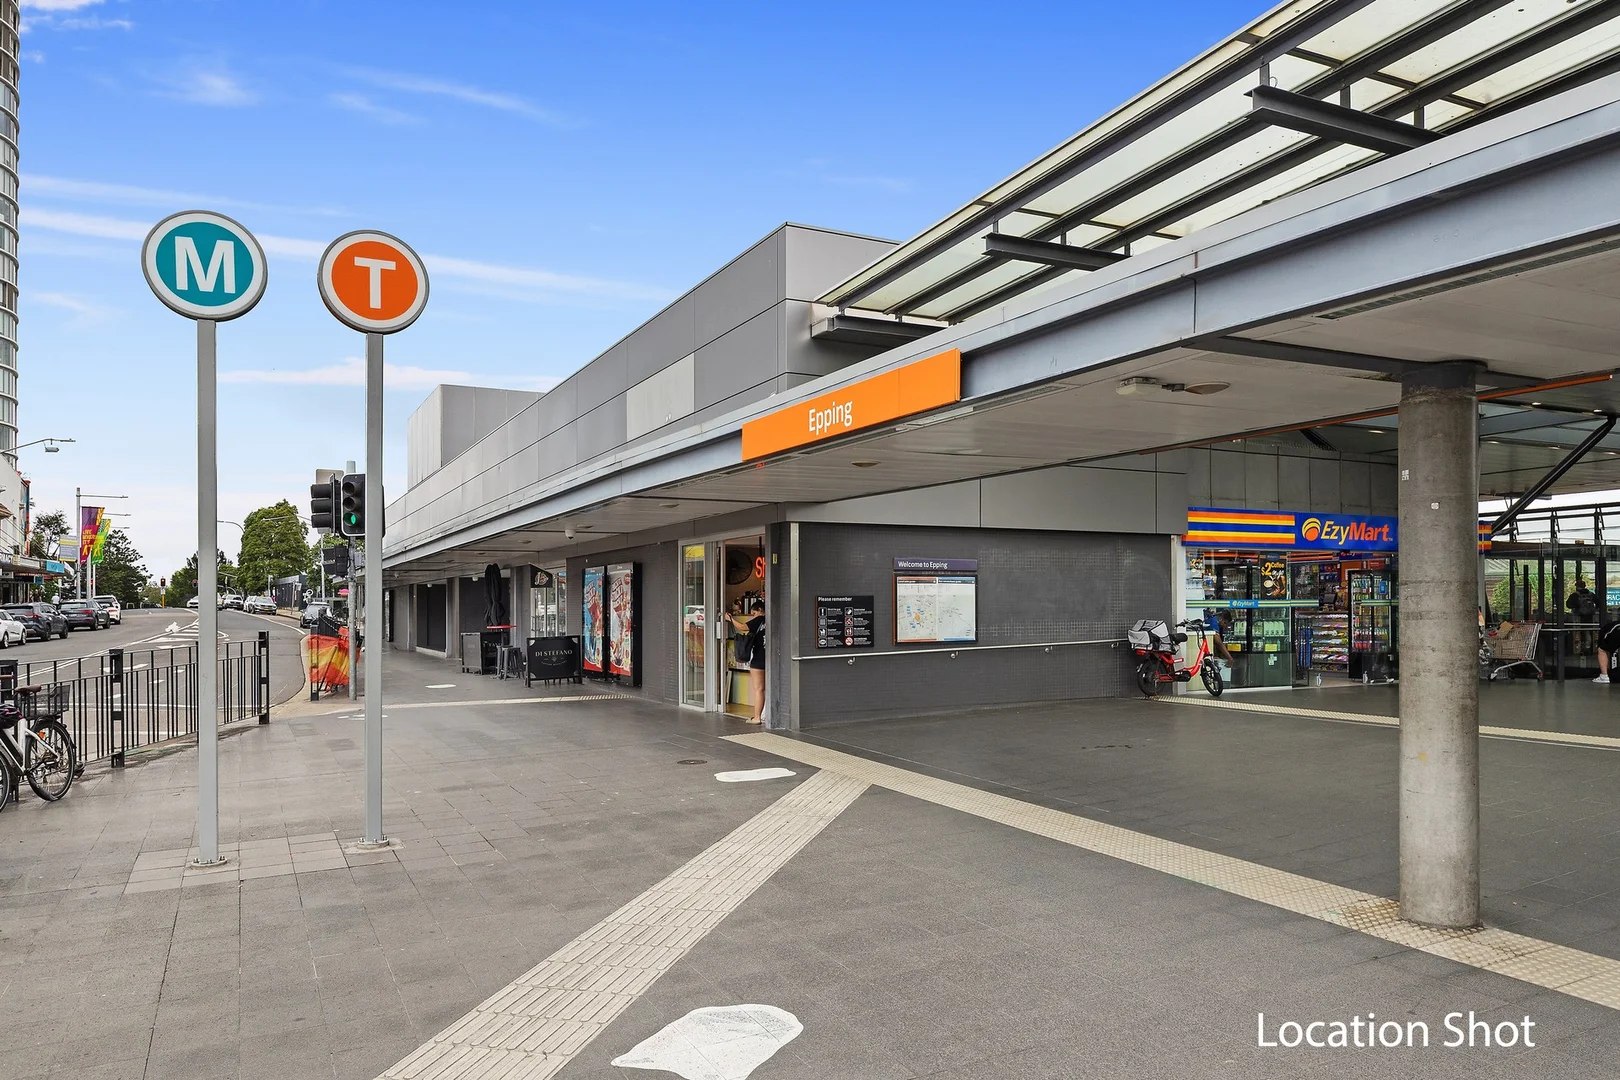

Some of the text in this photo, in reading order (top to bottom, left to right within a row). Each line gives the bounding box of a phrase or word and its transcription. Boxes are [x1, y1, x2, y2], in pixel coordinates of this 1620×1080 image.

[174, 235, 236, 294] M
[354, 256, 397, 310] T
[808, 400, 853, 436] Epping
[1320, 521, 1389, 546] EzyMart
[930, 561, 948, 569] Epping
